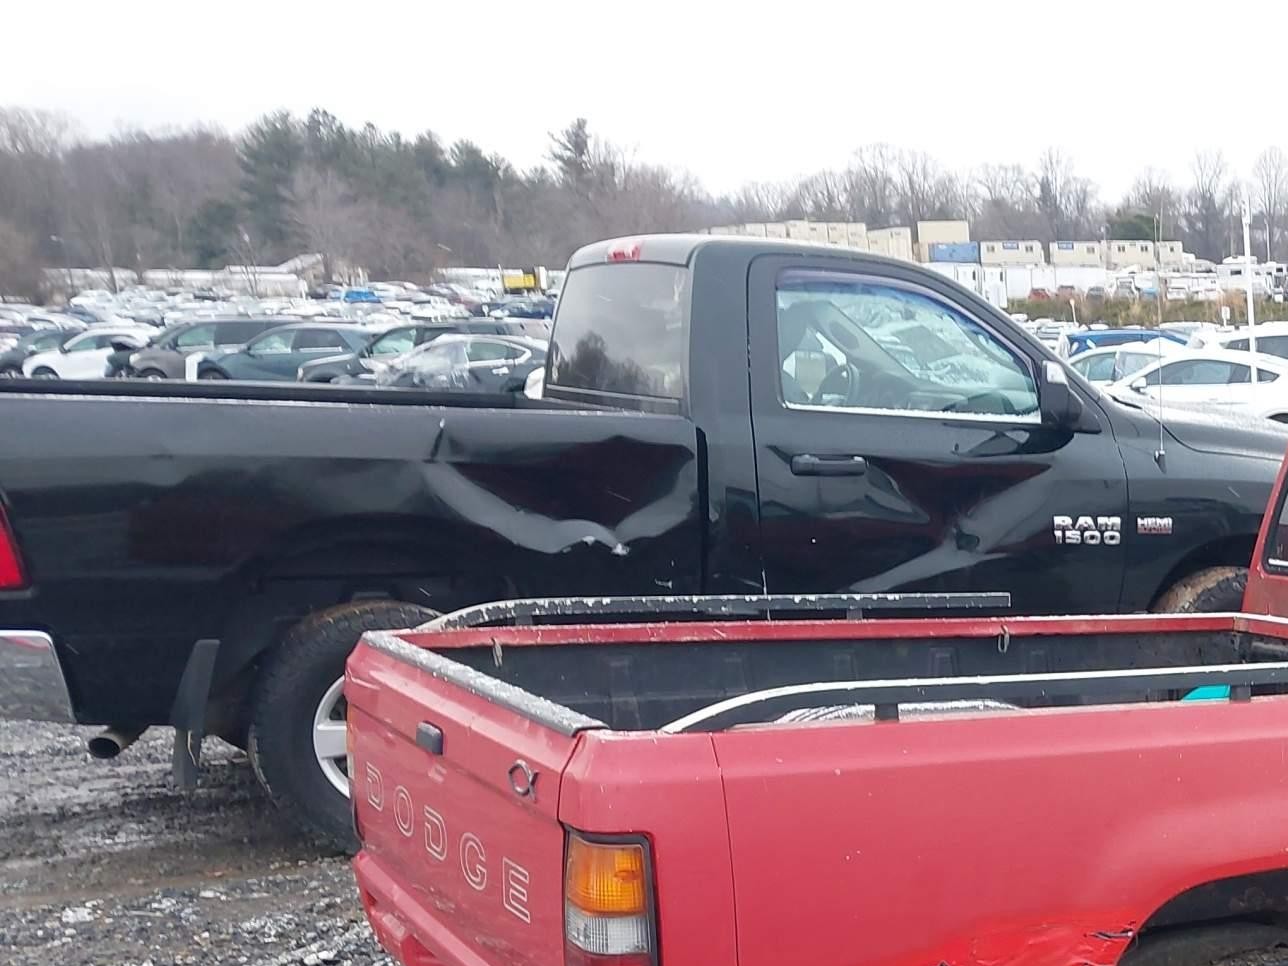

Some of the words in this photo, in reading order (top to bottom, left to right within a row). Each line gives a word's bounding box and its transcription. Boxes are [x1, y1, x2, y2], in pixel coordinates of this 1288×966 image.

[1053, 515, 1121, 530] RAM
[1054, 530, 1121, 545] 1500
[365, 761, 532, 924] DODGE
